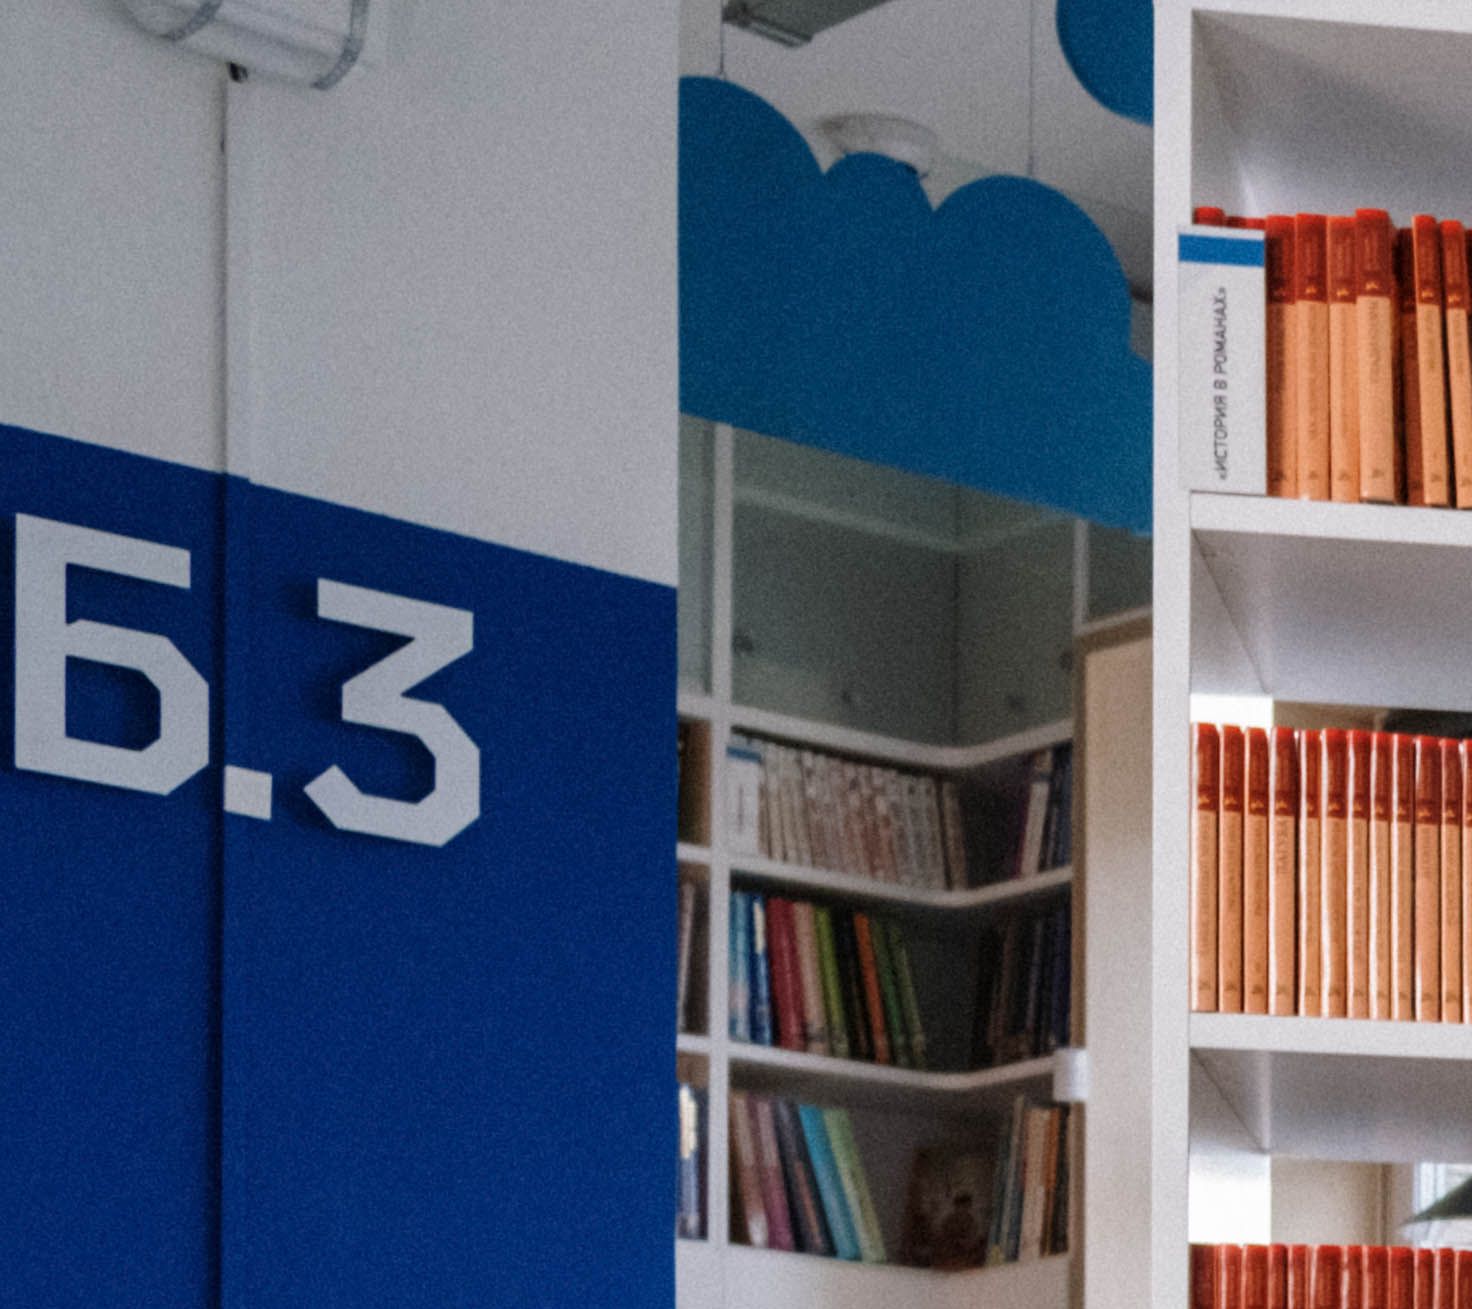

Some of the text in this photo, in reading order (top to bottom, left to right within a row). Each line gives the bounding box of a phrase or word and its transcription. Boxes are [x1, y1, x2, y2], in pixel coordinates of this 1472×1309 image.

[1211, 286, 1228, 482] «ИСТОРИЯ В РОМАНАХ»
[14, 512, 481, 847] Б.3
